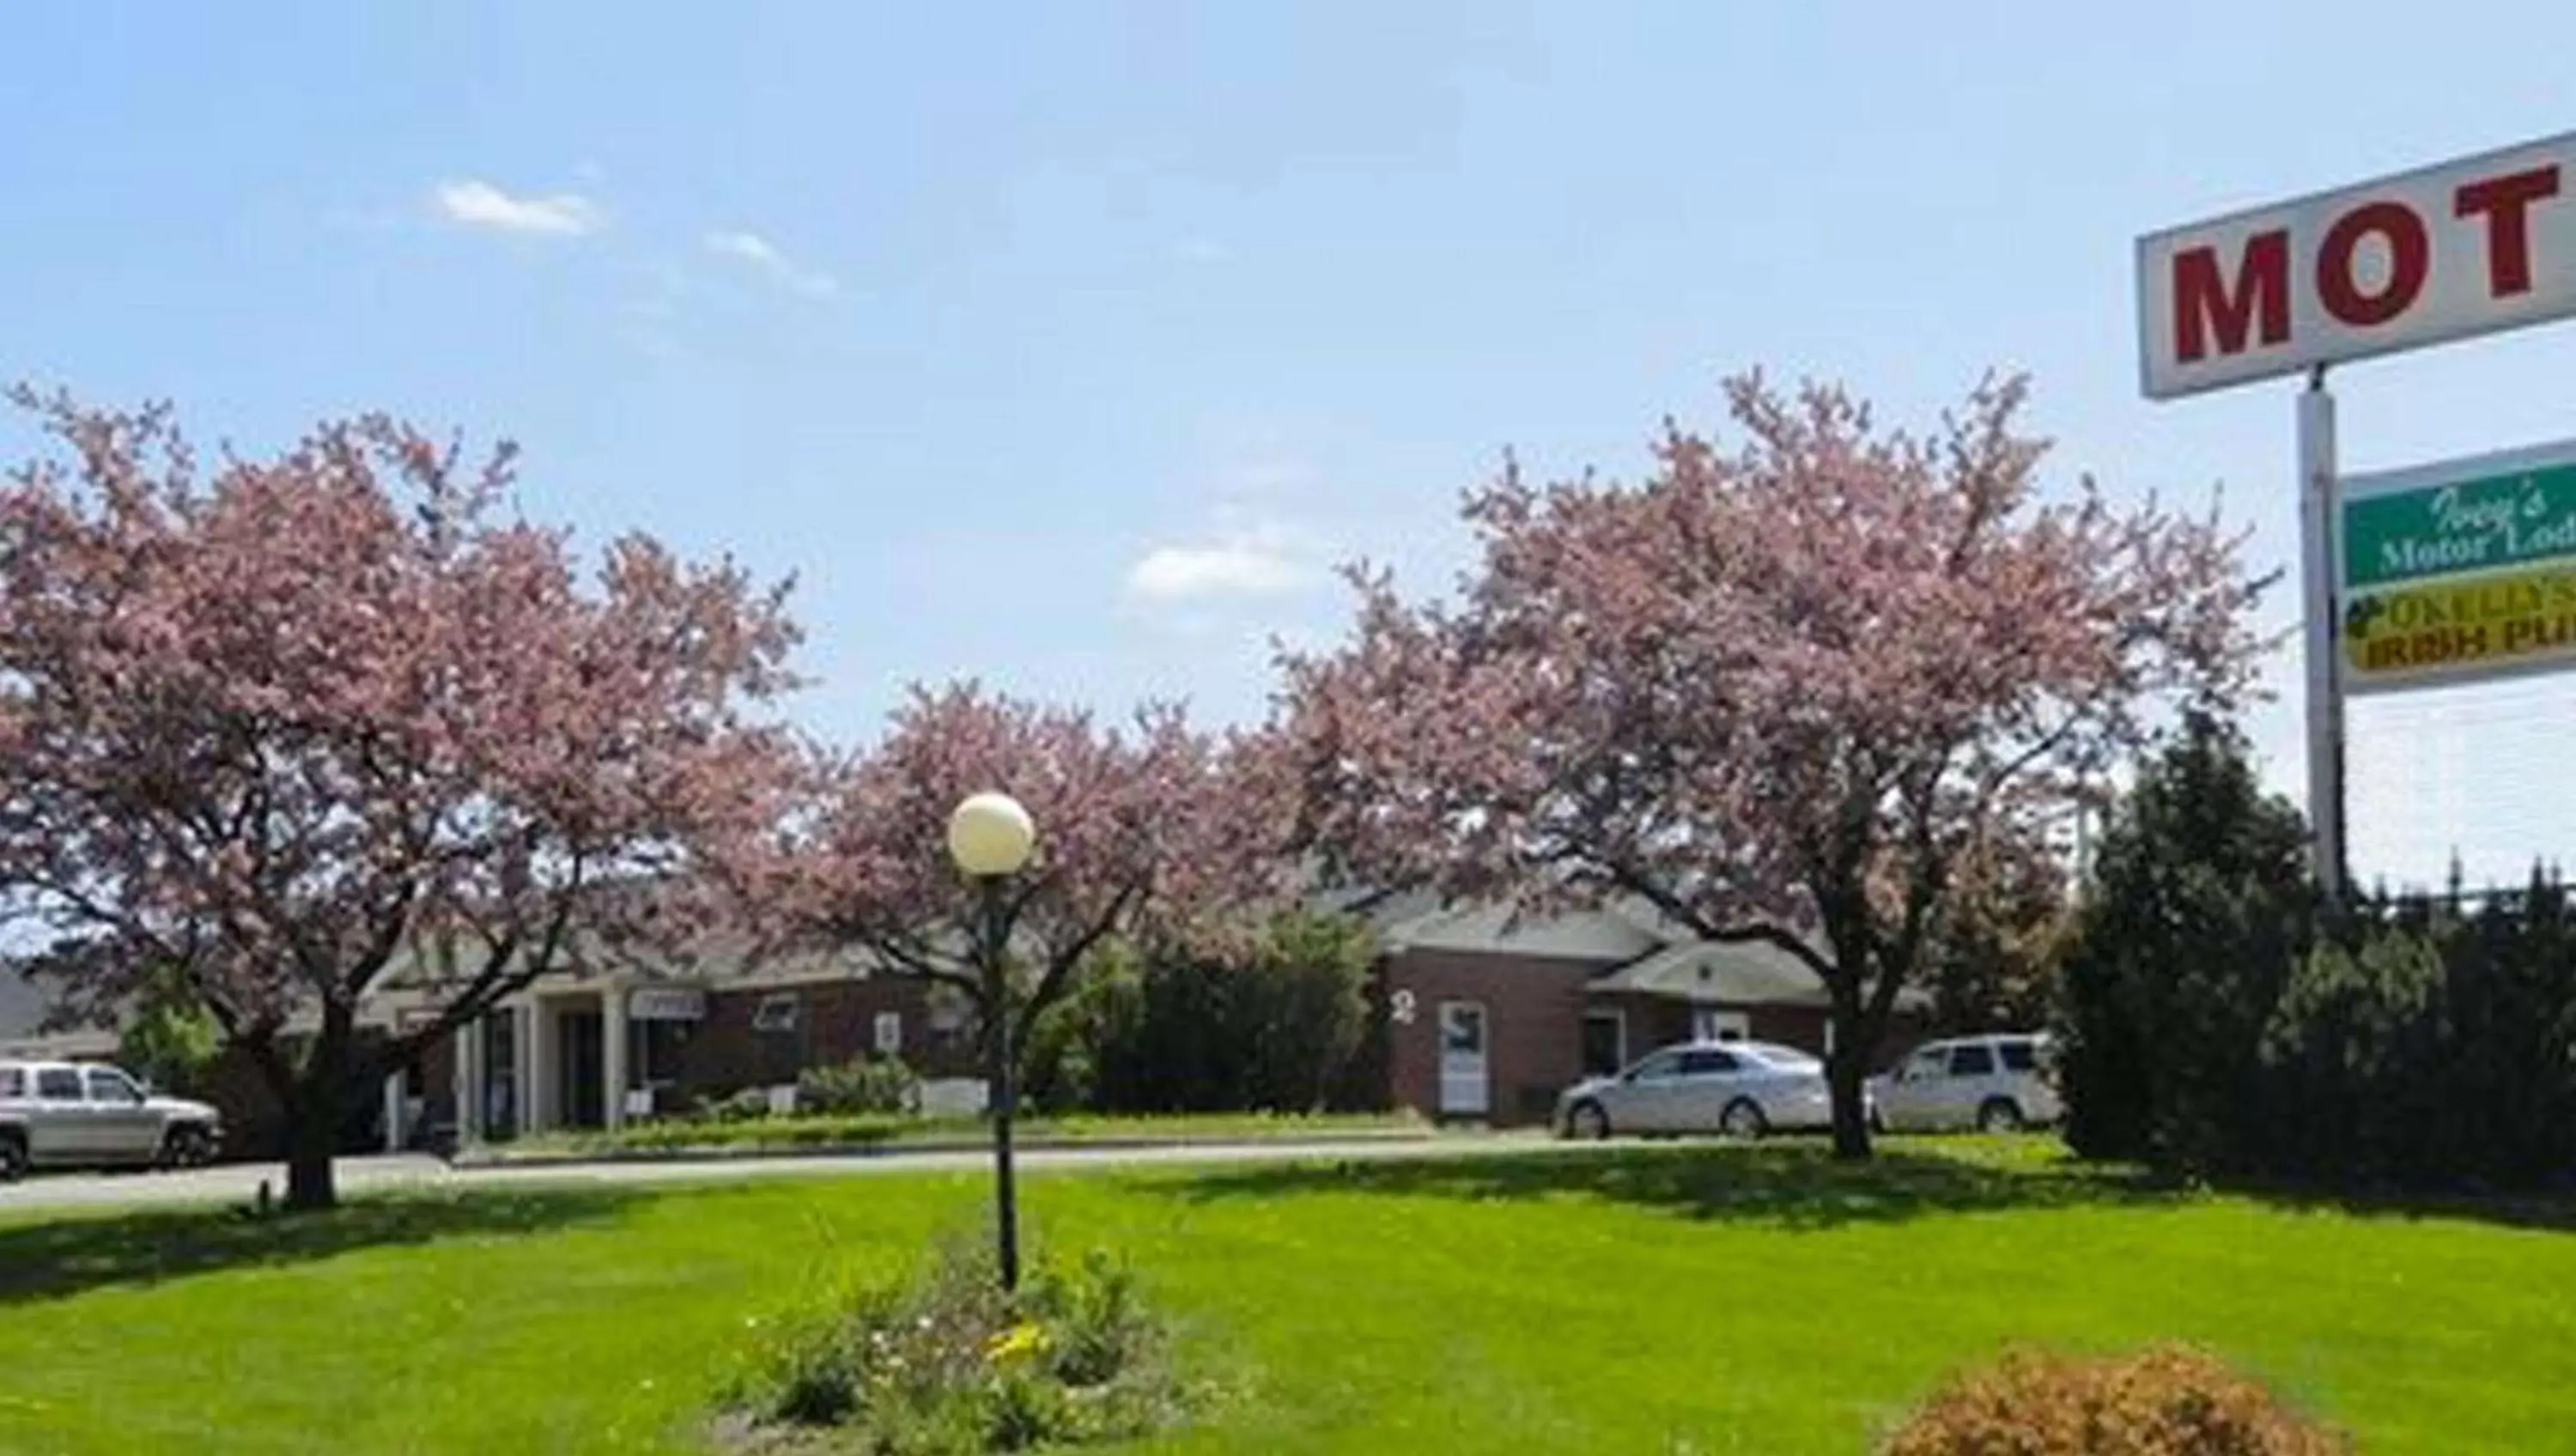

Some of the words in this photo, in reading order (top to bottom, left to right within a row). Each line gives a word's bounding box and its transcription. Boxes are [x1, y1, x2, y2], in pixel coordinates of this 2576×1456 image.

[2173, 164, 2561, 363] MOT
[2379, 534, 2490, 573] Motor
[2366, 625, 2488, 670] IRISH
[2502, 613, 2576, 652] PU
